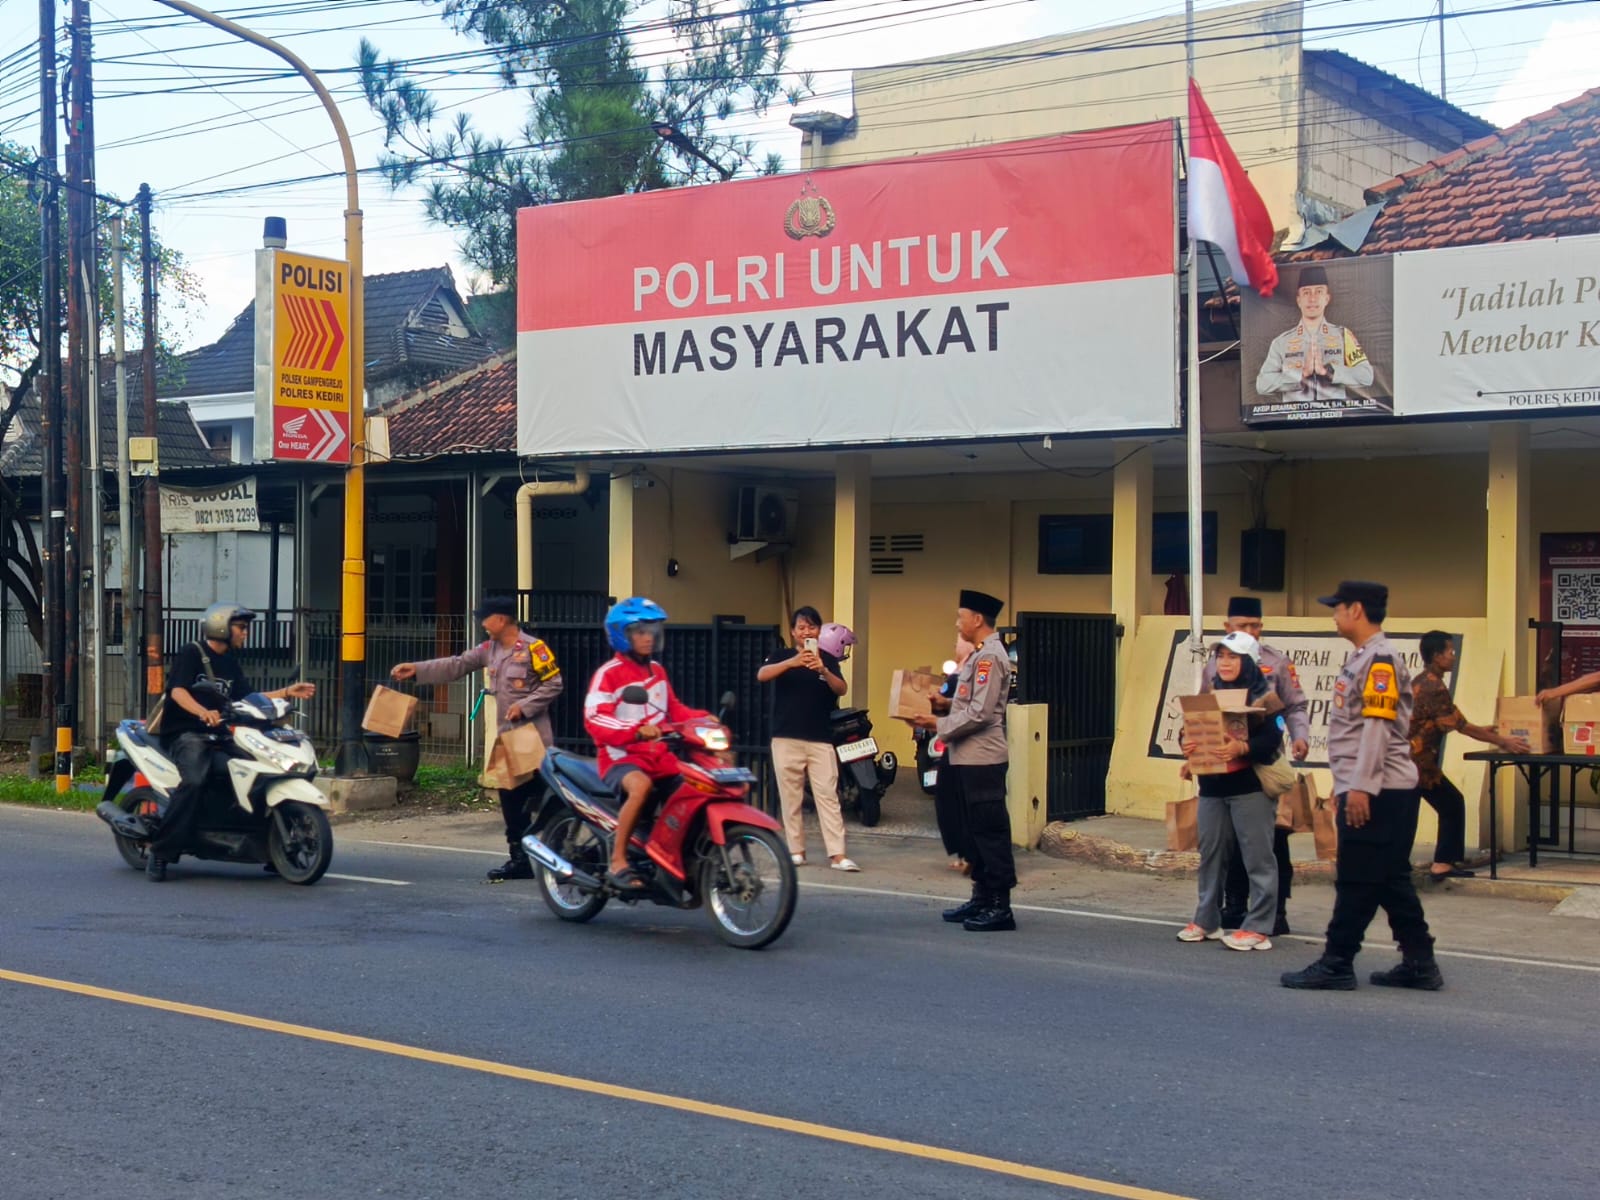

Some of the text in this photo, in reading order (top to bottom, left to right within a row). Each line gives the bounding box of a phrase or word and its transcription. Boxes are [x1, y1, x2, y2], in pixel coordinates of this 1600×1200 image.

[281, 262, 342, 294] POLISI
[632, 226, 1010, 312] POLRI UNTUK
[632, 301, 1010, 377] MASYARAKAT
[1439, 323, 1569, 357] Menebar
[280, 387, 344, 403] POLRES KEDIRI
[281, 373, 302, 385] POLSEK
[1508, 393, 1560, 406] POLRES
